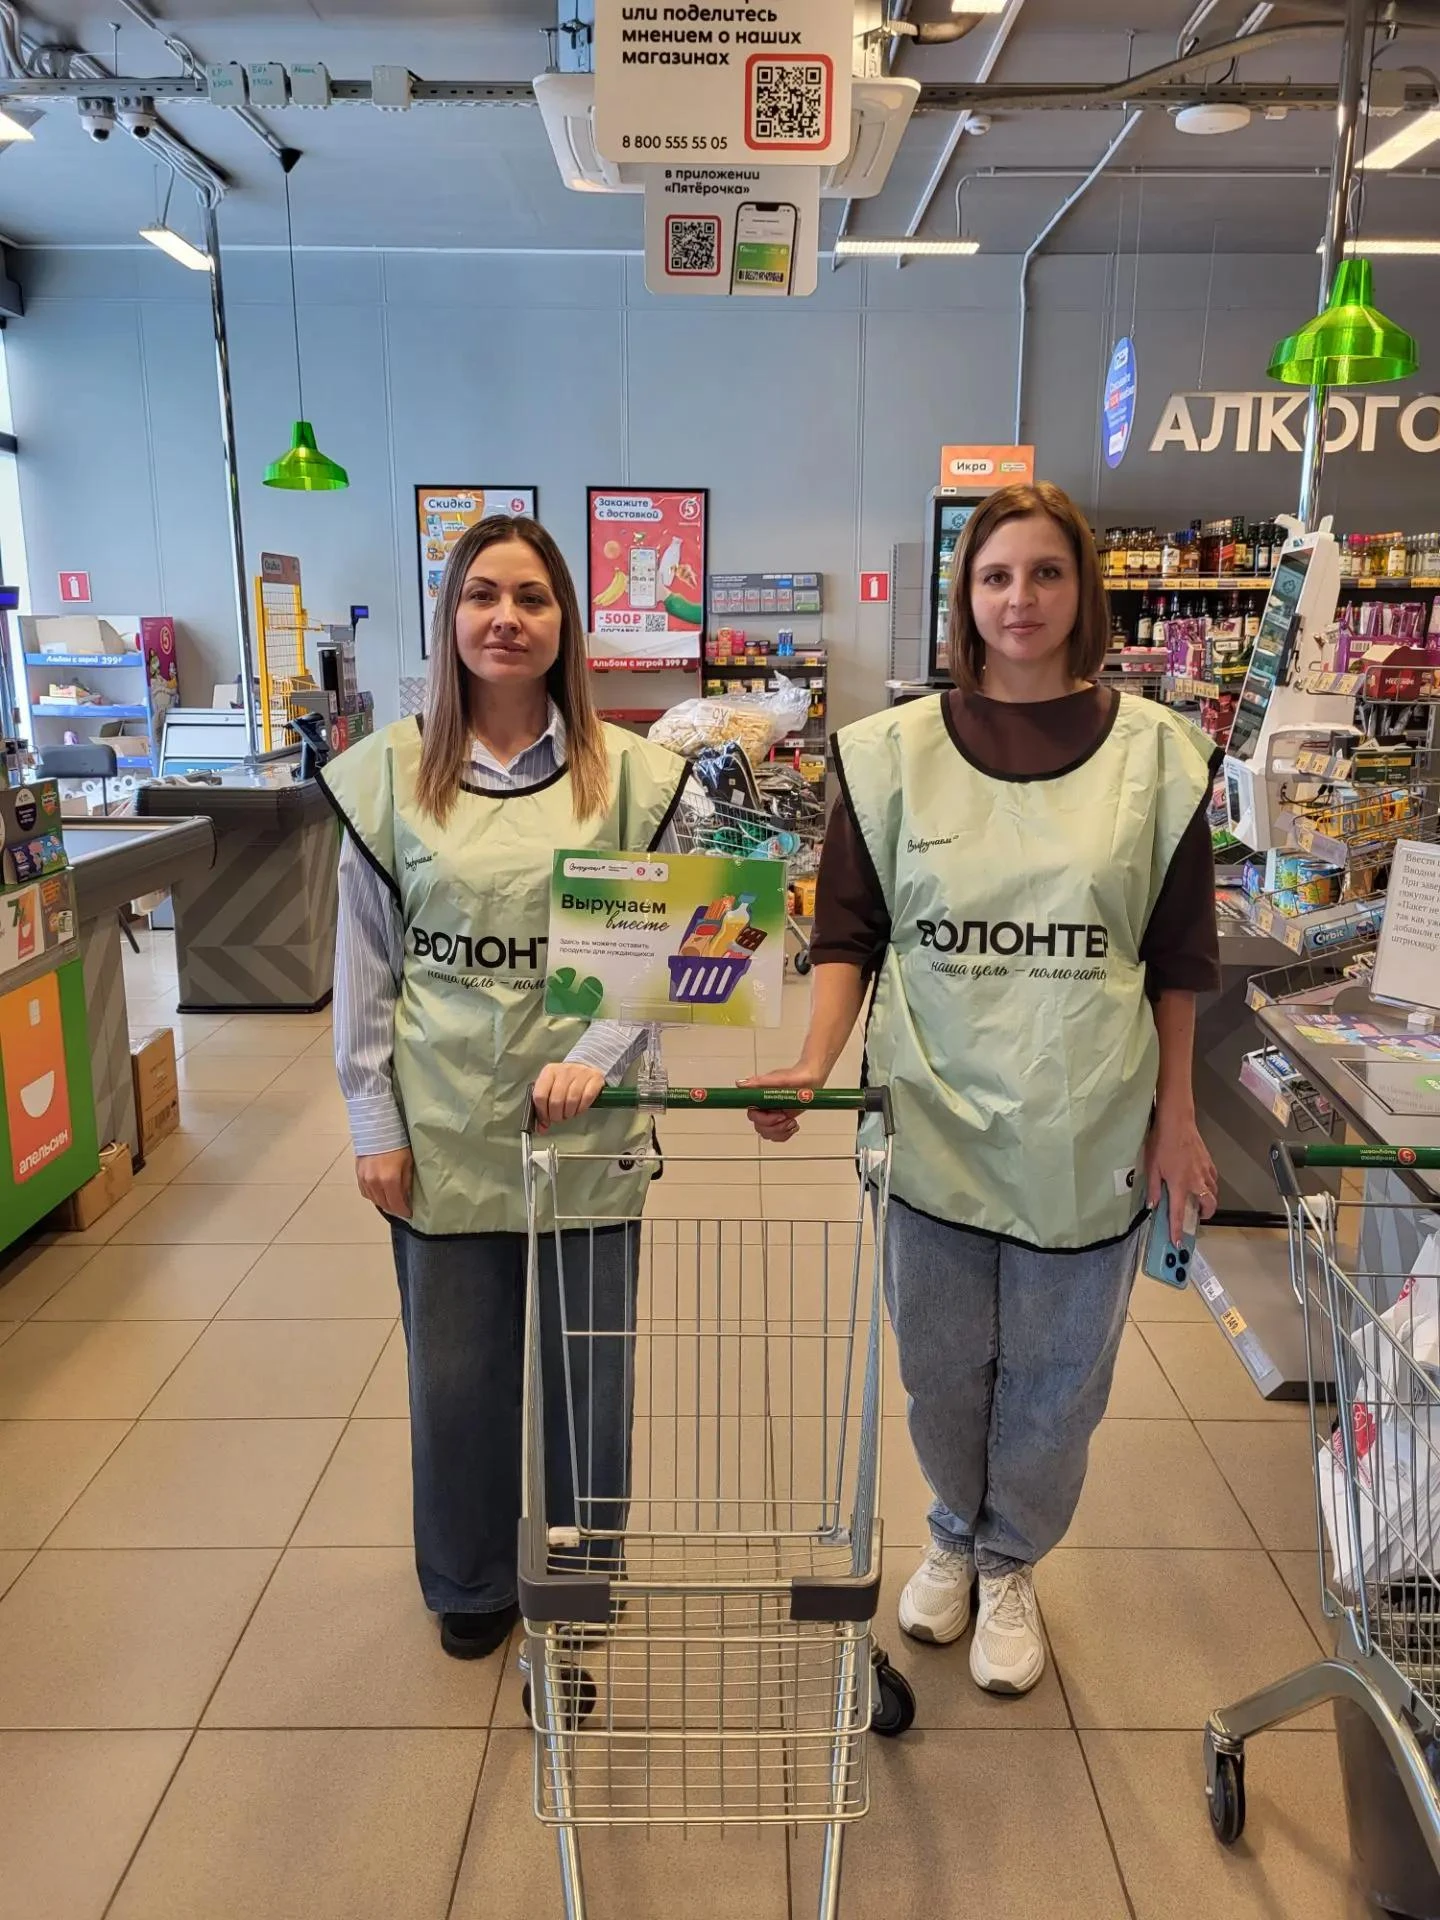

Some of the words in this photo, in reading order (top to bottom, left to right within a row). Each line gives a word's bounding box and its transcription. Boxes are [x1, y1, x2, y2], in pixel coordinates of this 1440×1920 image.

[622, 7, 657, 21] или
[663, 5, 778, 22] поделитесь
[622, 28, 714, 43] мнением
[718, 30, 730, 44] о
[736, 30, 802, 44] наших
[622, 51, 730, 65] магазинах
[622, 136, 630, 148] 8
[634, 136, 662, 149] 800
[665, 136, 688, 149] 555
[692, 136, 706, 149] 55
[711, 136, 728, 150] 05
[665, 170, 672, 180] в
[676, 170, 760, 183] приложении
[664, 182, 750, 196] «Пятёрочка»
[1150, 395, 1440, 454] АЛКОГО
[956, 462, 987, 472] Икра
[428, 498, 472, 509] Скидка
[599, 498, 649, 508] Закажите
[606, 508, 659, 519] доставкой
[592, 659, 627, 667] Альбом
[636, 659, 663, 668] игрой
[561, 894, 666, 915] Выручаем
[605, 910, 671, 932] вместе
[916, 919, 1108, 958] ВОЛОНТЕ
[931, 960, 968, 977] наша
[971, 965, 1010, 980] цель
[1028, 966, 1108, 980] помогать
[428, 969, 459, 984] наша
[460, 977, 496, 989] цель
[19, 1128, 68, 1174] апельсин
